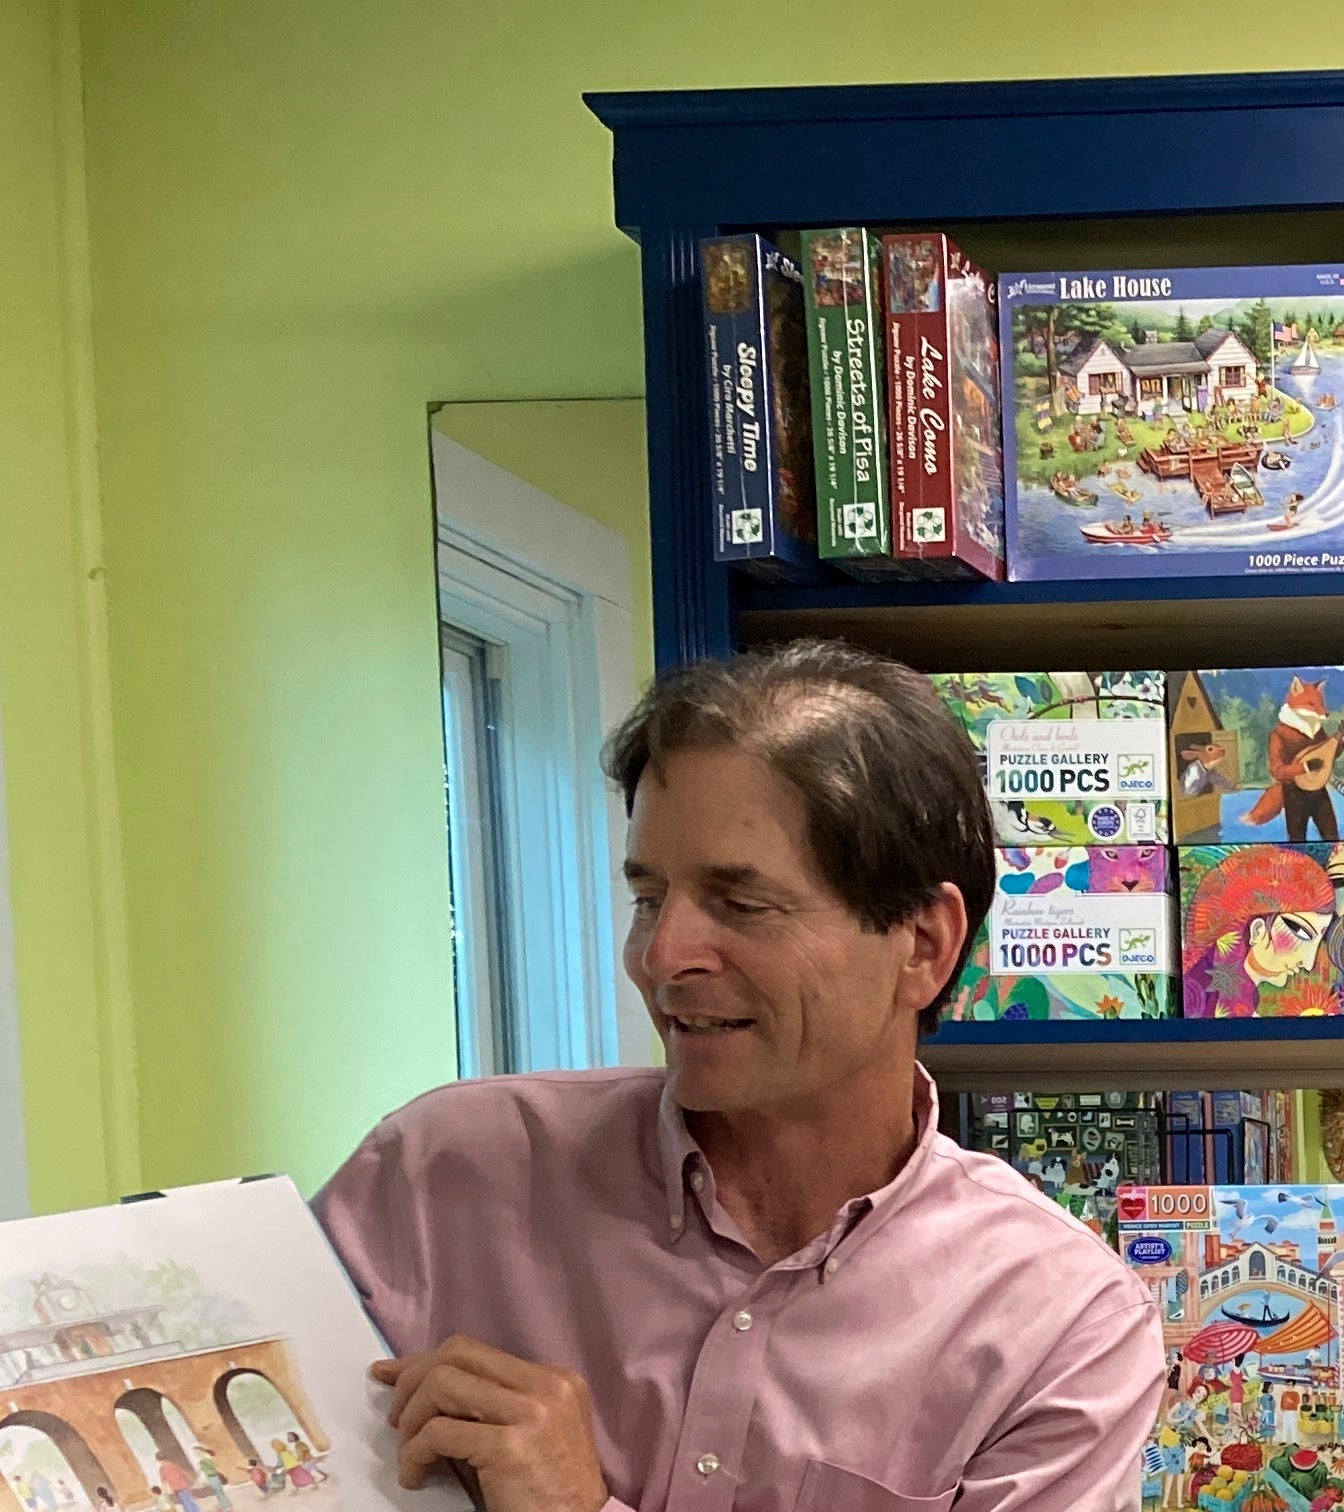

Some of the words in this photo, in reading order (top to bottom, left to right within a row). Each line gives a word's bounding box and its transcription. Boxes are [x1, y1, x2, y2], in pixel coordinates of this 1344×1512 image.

[1059, 277, 1107, 299] Lake
[1112, 275, 1172, 298] House
[831, 350, 843, 364] by
[847, 318, 868, 408] Streets
[904, 356, 915, 368] by
[920, 336, 944, 400] Lake
[736, 342, 757, 418] Sleepy
[833, 366, 845, 410] Dominic
[905, 370, 917, 415] Dominic
[836, 411, 848, 454] Davison
[852, 413, 873, 433] of
[907, 416, 917, 460] Davison
[919, 408, 945, 476] Como
[856, 440, 873, 482] Pisa
[1249, 554, 1280, 567] 1000
[1284, 553, 1318, 566] Piece
[1000, 754, 1048, 766] PUZZLE
[1051, 753, 1109, 765] GALLERY
[1060, 768, 1110, 793] PCS
[1120, 780, 1153, 788] DJECO
[1002, 928, 1050, 940] PUZZLE
[1053, 927, 1111, 939] GALLERY
[1062, 942, 1112, 967] PCS
[1122, 954, 1154, 963] DJECO
